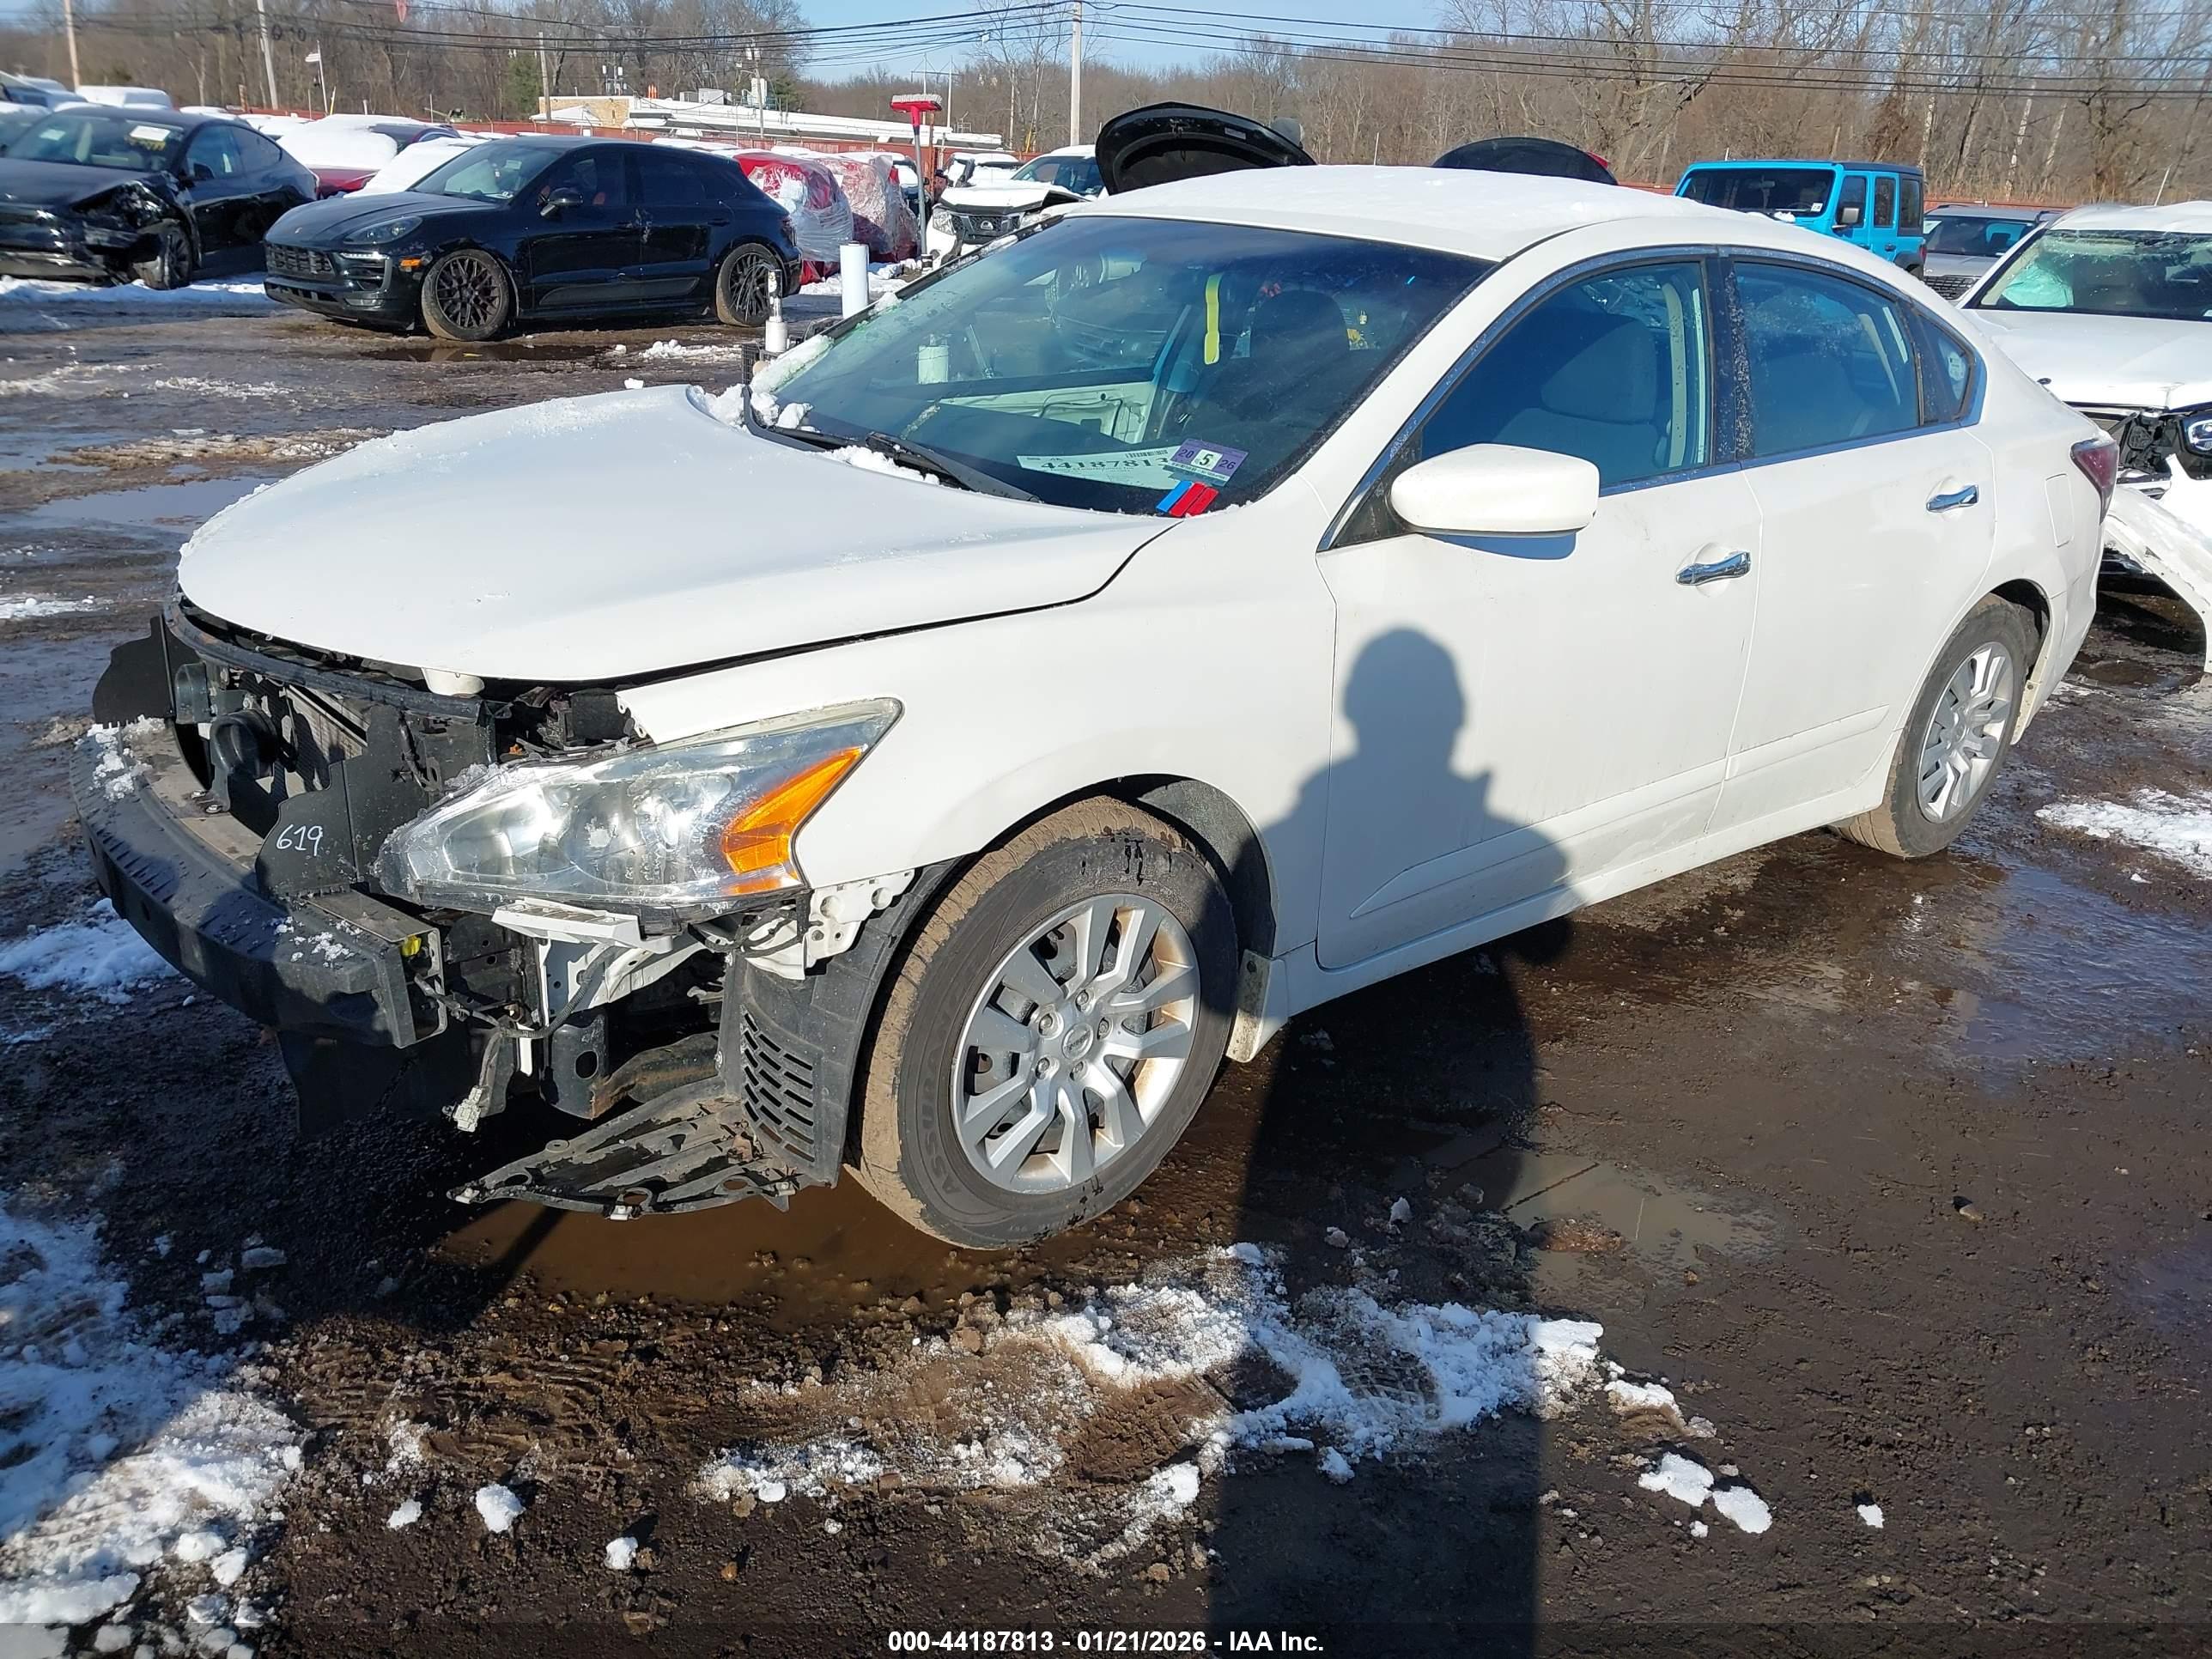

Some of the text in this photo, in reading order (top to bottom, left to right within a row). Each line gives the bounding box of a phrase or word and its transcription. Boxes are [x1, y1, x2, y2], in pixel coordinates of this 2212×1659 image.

[1178, 449, 1237, 470] 20 5 26
[276, 824, 323, 857] 619
